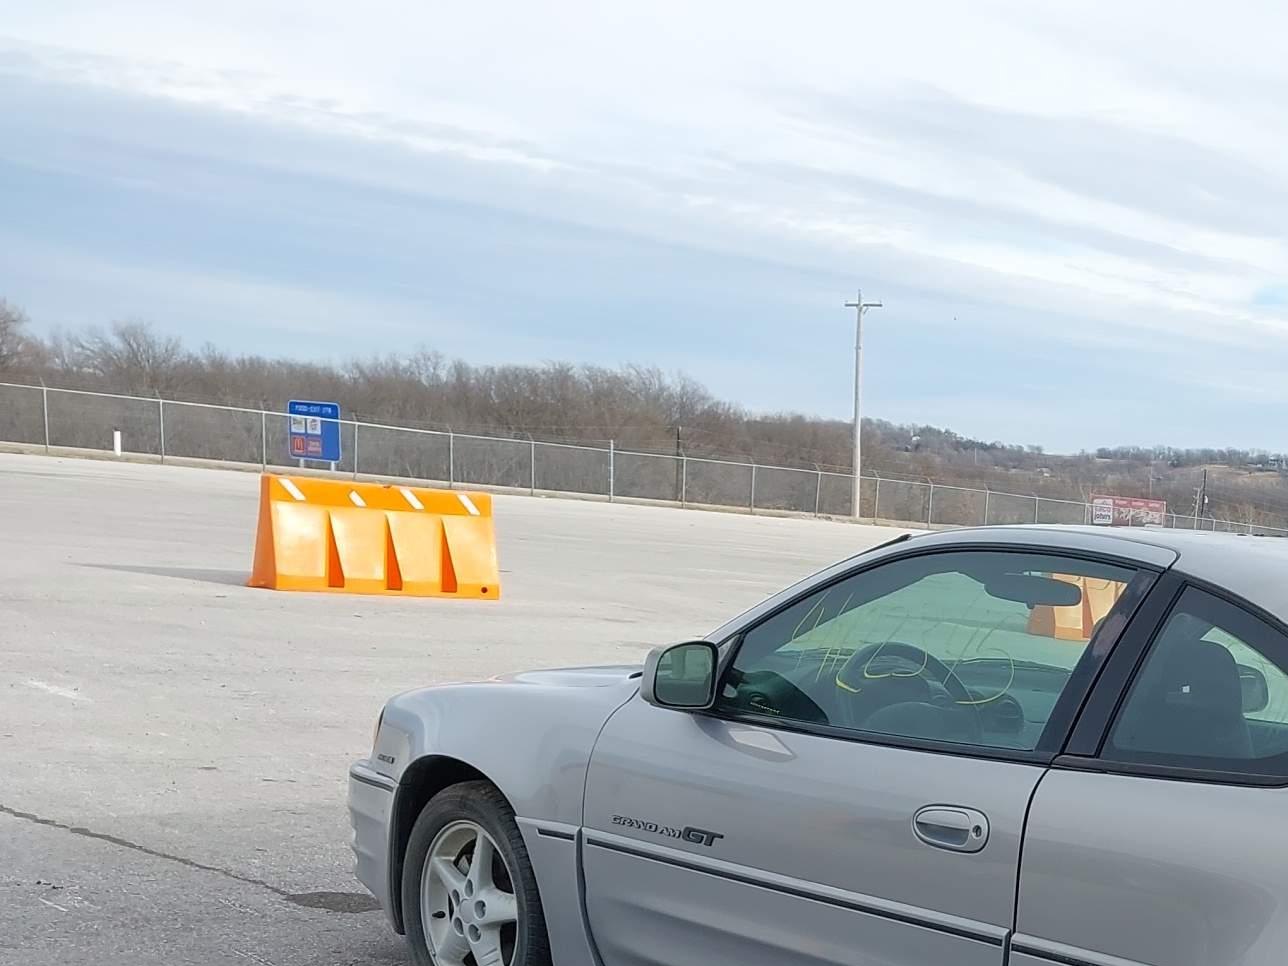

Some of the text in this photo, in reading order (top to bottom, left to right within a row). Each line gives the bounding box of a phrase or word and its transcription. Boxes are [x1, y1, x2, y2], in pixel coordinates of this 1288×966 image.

[611, 814, 724, 847] GRAND AM GT
